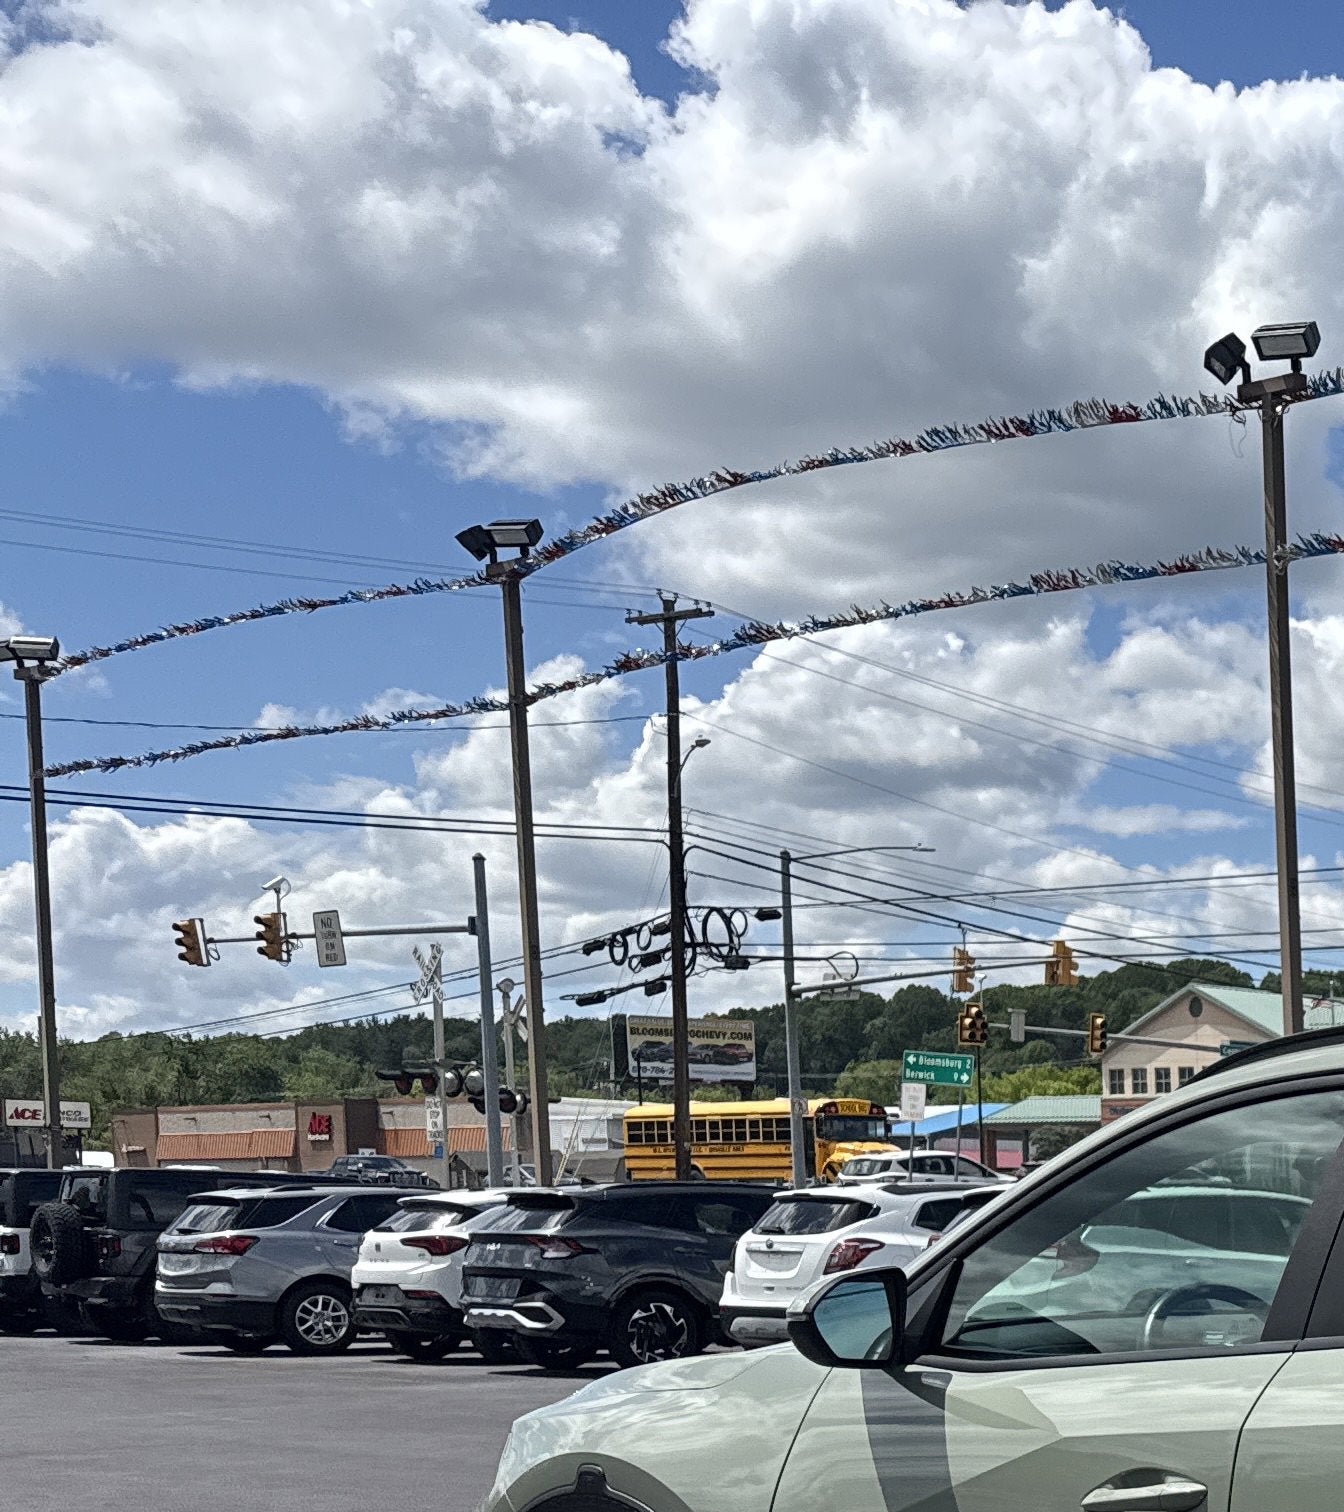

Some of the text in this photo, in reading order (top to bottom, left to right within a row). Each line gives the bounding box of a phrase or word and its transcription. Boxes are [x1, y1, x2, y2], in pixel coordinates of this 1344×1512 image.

[965, 1058, 971, 1069] 2
[8, 1106, 42, 1121] ACE
[308, 1112, 332, 1134] ACE
